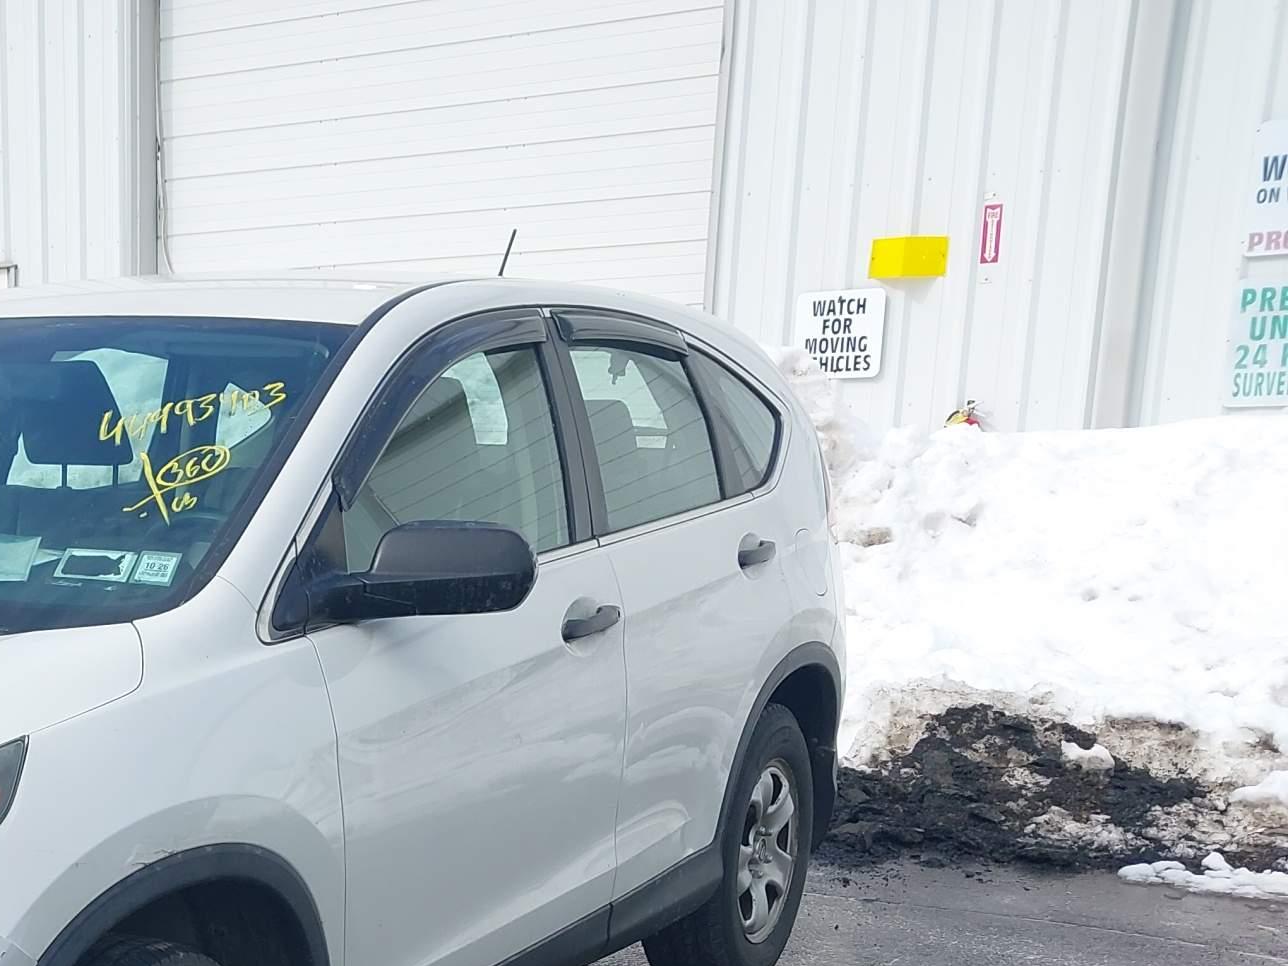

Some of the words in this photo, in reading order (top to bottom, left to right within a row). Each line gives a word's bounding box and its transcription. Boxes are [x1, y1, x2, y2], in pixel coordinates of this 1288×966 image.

[1262, 154, 1288, 182] W
[1256, 187, 1280, 204] ON
[813, 297, 867, 317] WATCH
[822, 317, 853, 335] FOR
[805, 335, 868, 354] MOVING
[812, 354, 872, 373] HICLES
[1234, 343, 1268, 369] 24
[1232, 371, 1288, 397] SURVE
